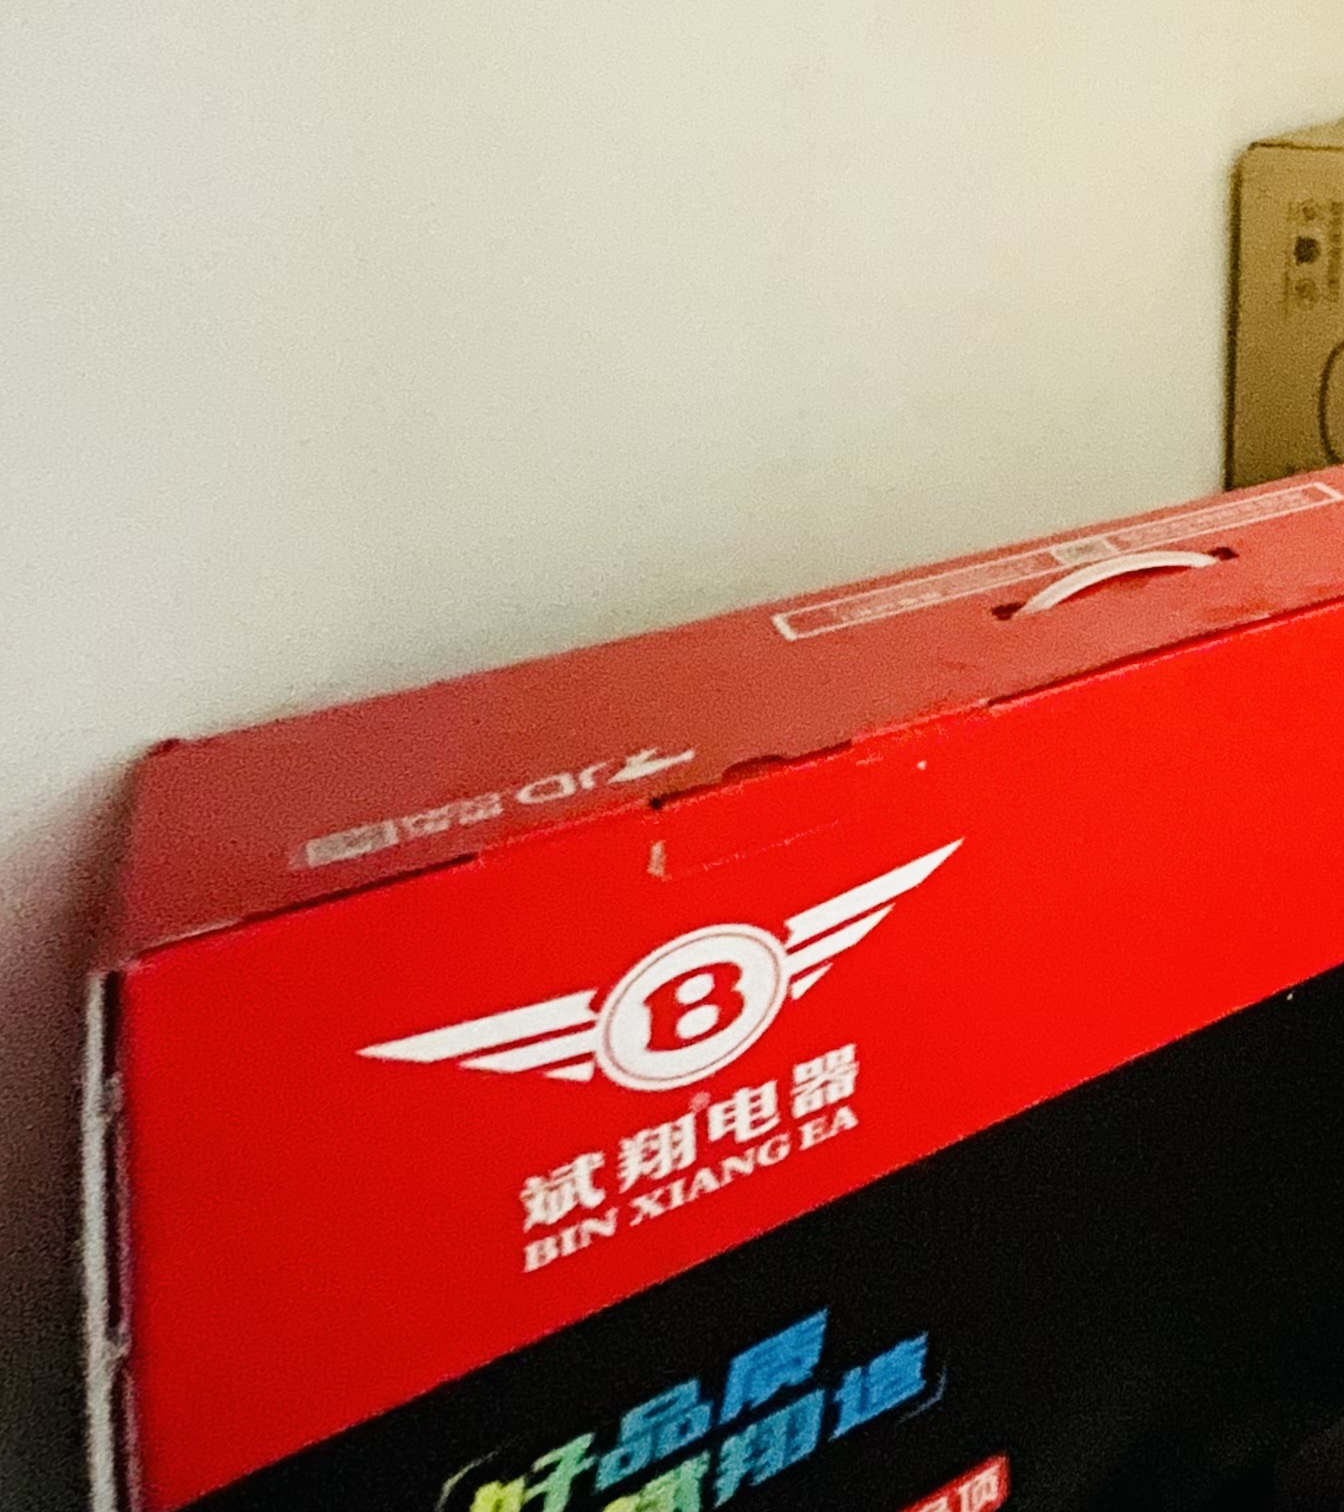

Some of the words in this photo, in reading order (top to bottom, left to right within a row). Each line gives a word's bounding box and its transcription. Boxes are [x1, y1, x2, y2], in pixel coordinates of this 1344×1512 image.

[519, 1043, 860, 1234] 斌翔电器
[523, 1206, 620, 1274] BIN
[629, 1132, 791, 1228] XIANG
[797, 1105, 860, 1151] EA
